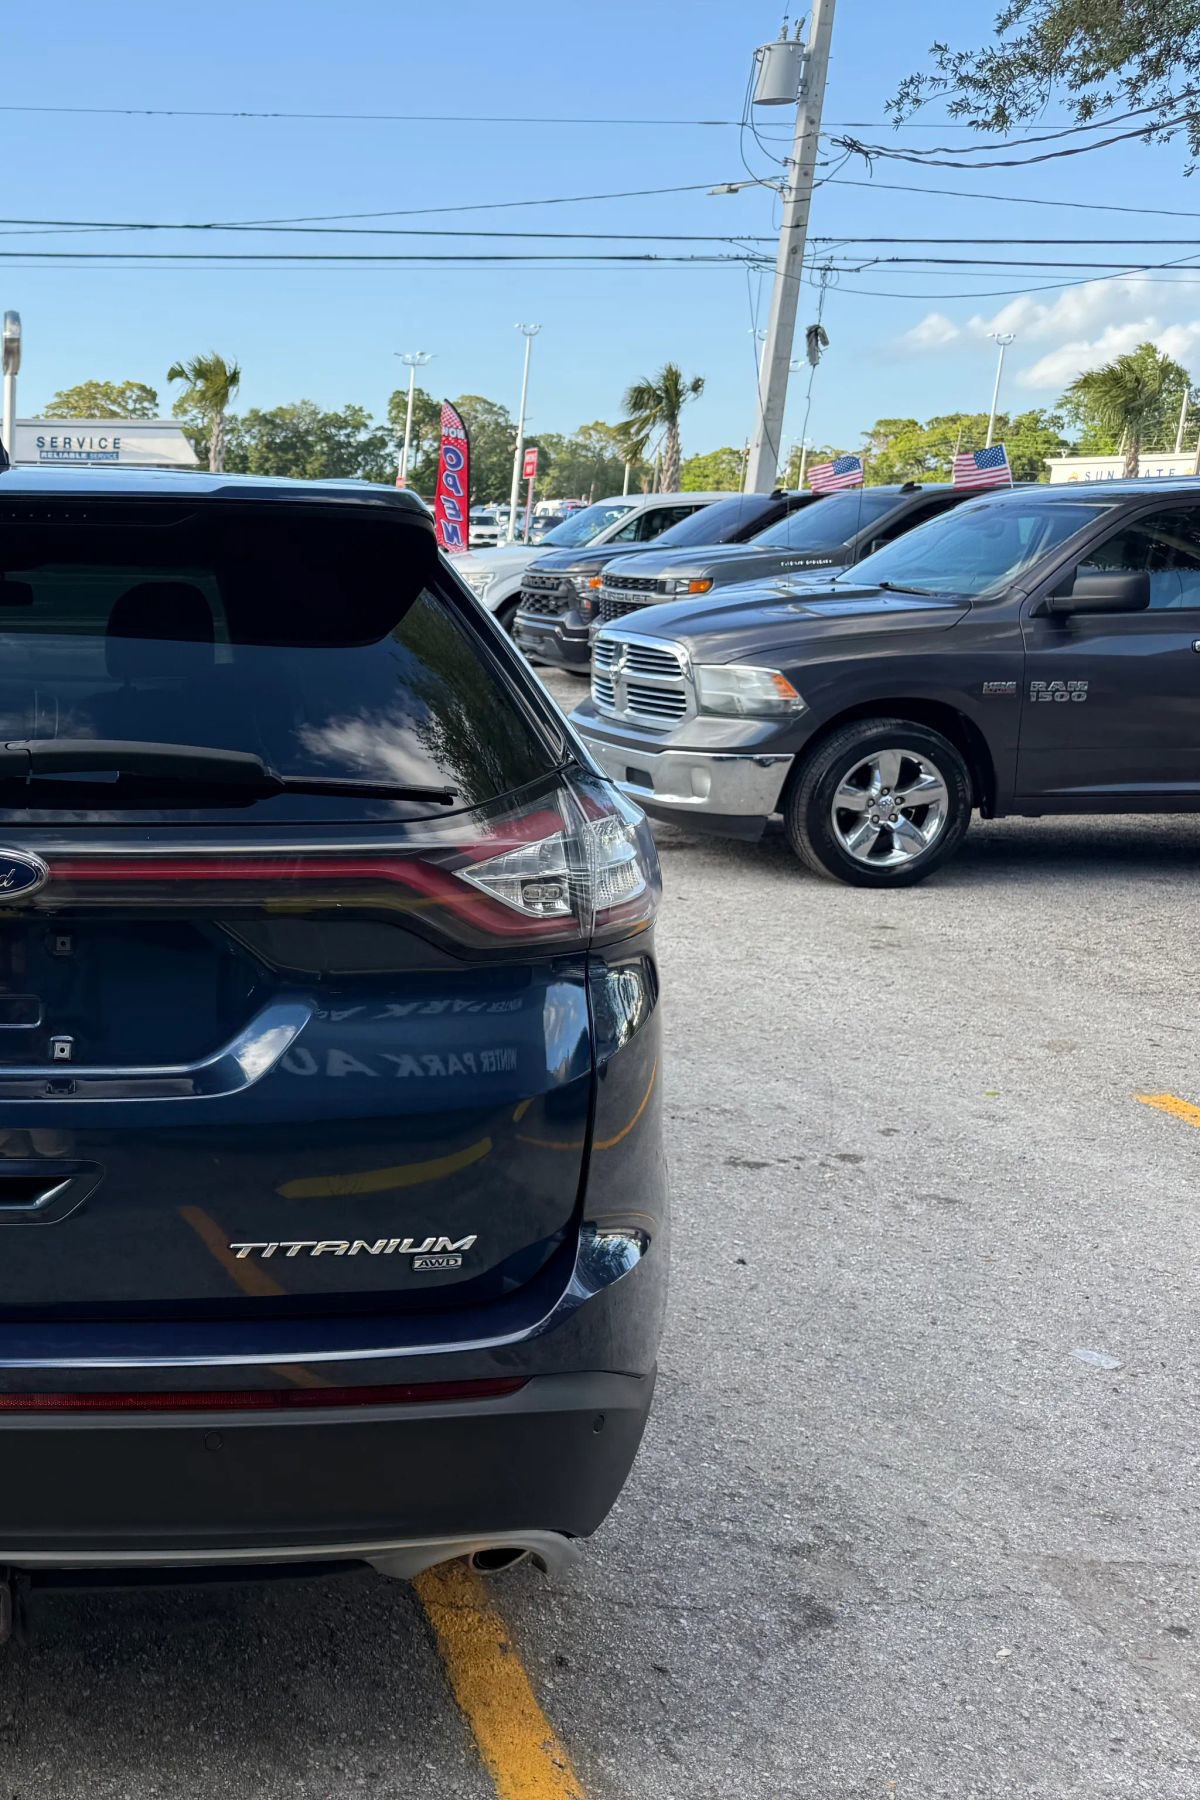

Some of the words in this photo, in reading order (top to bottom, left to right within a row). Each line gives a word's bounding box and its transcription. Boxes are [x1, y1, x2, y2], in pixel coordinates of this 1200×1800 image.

[36, 436, 121, 449] SERVICE
[41, 451, 88, 459] RELIABLE
[1084, 470, 1115, 481] SUN
[1030, 681, 1089, 691] RAM
[1030, 691, 1087, 701] 1500
[230, 1235, 478, 1259] TITANIUM
[417, 1258, 459, 1269] AWD
